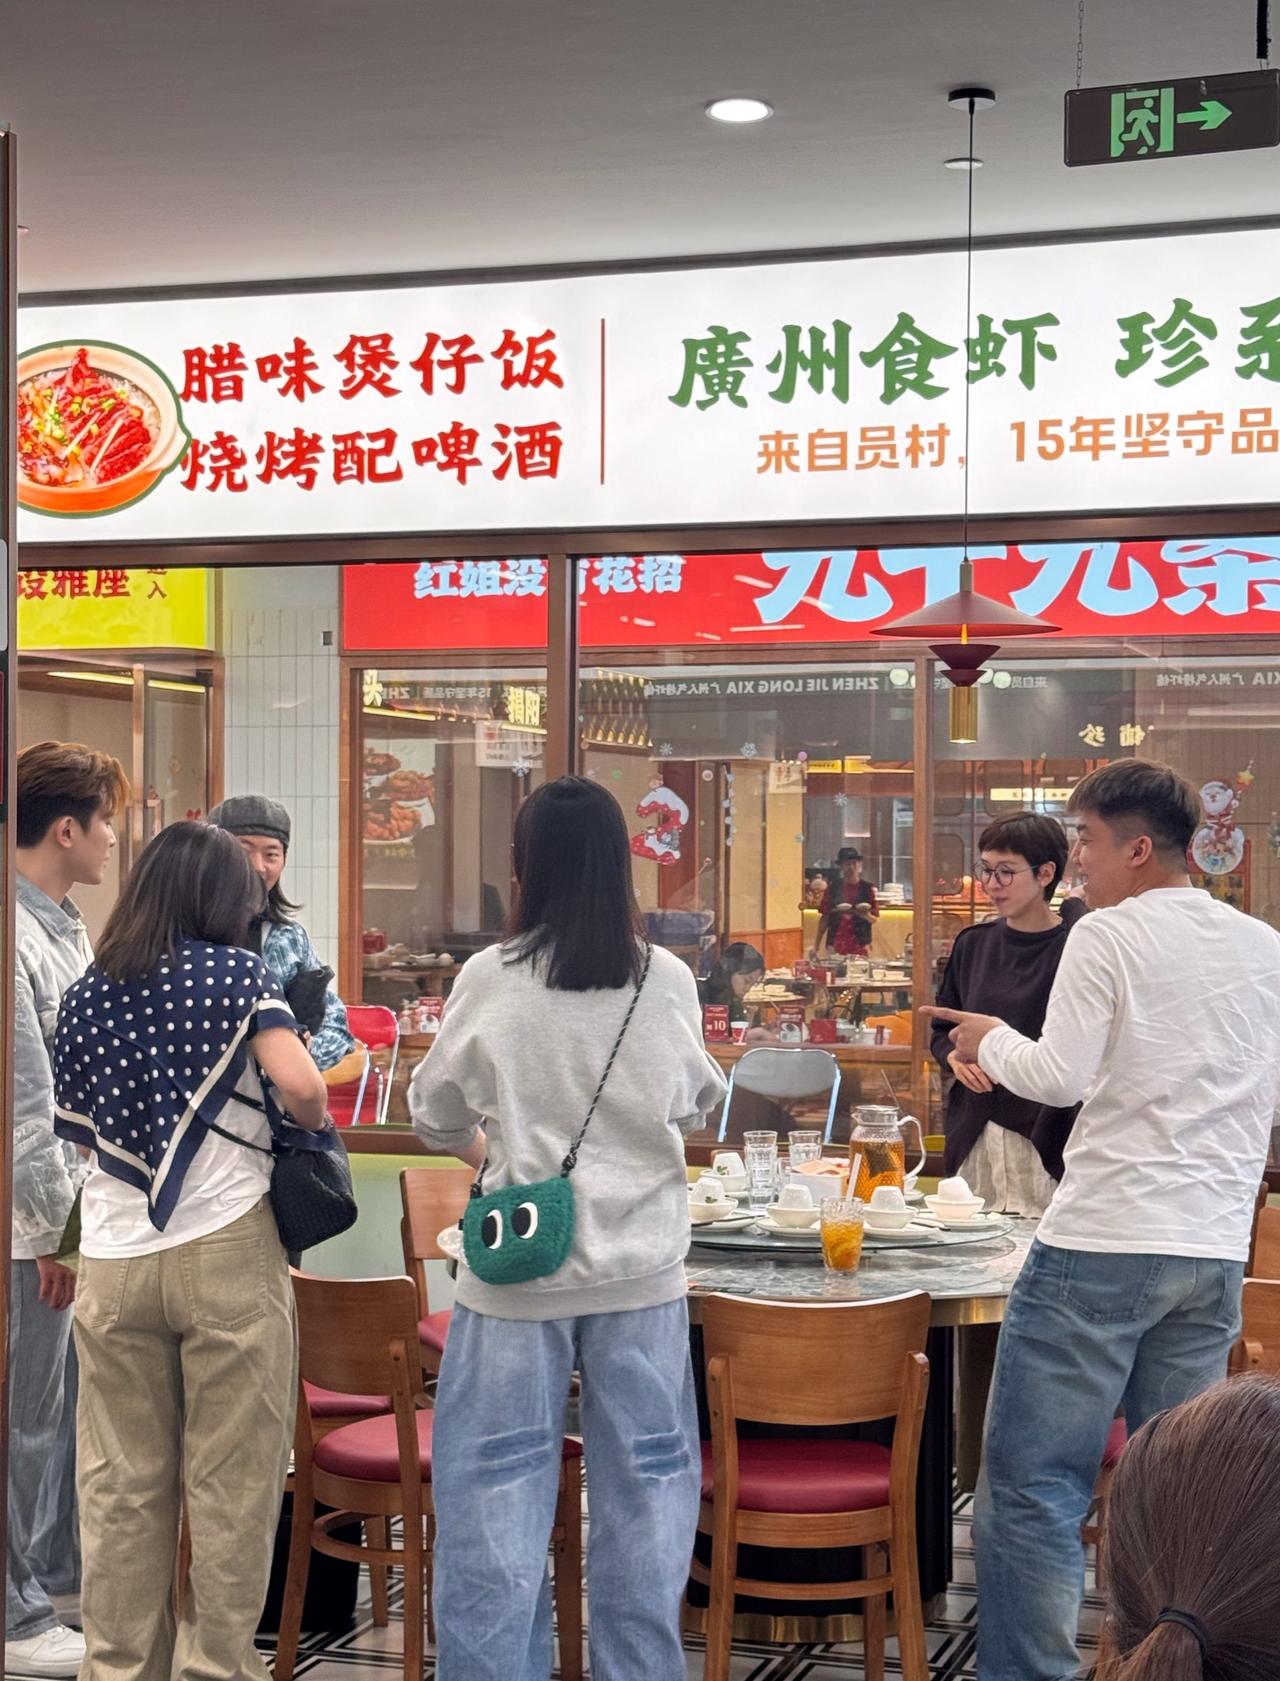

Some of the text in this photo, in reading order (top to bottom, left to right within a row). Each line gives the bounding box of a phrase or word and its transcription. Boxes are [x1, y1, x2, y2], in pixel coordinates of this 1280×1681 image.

[180, 329, 565, 403] 腊味煲仔饭
[668, 312, 1060, 410] 廣州食虾
[179, 420, 564, 493] 烧烤配啤酒
[1010, 407, 1280, 462] 15年坚守品
